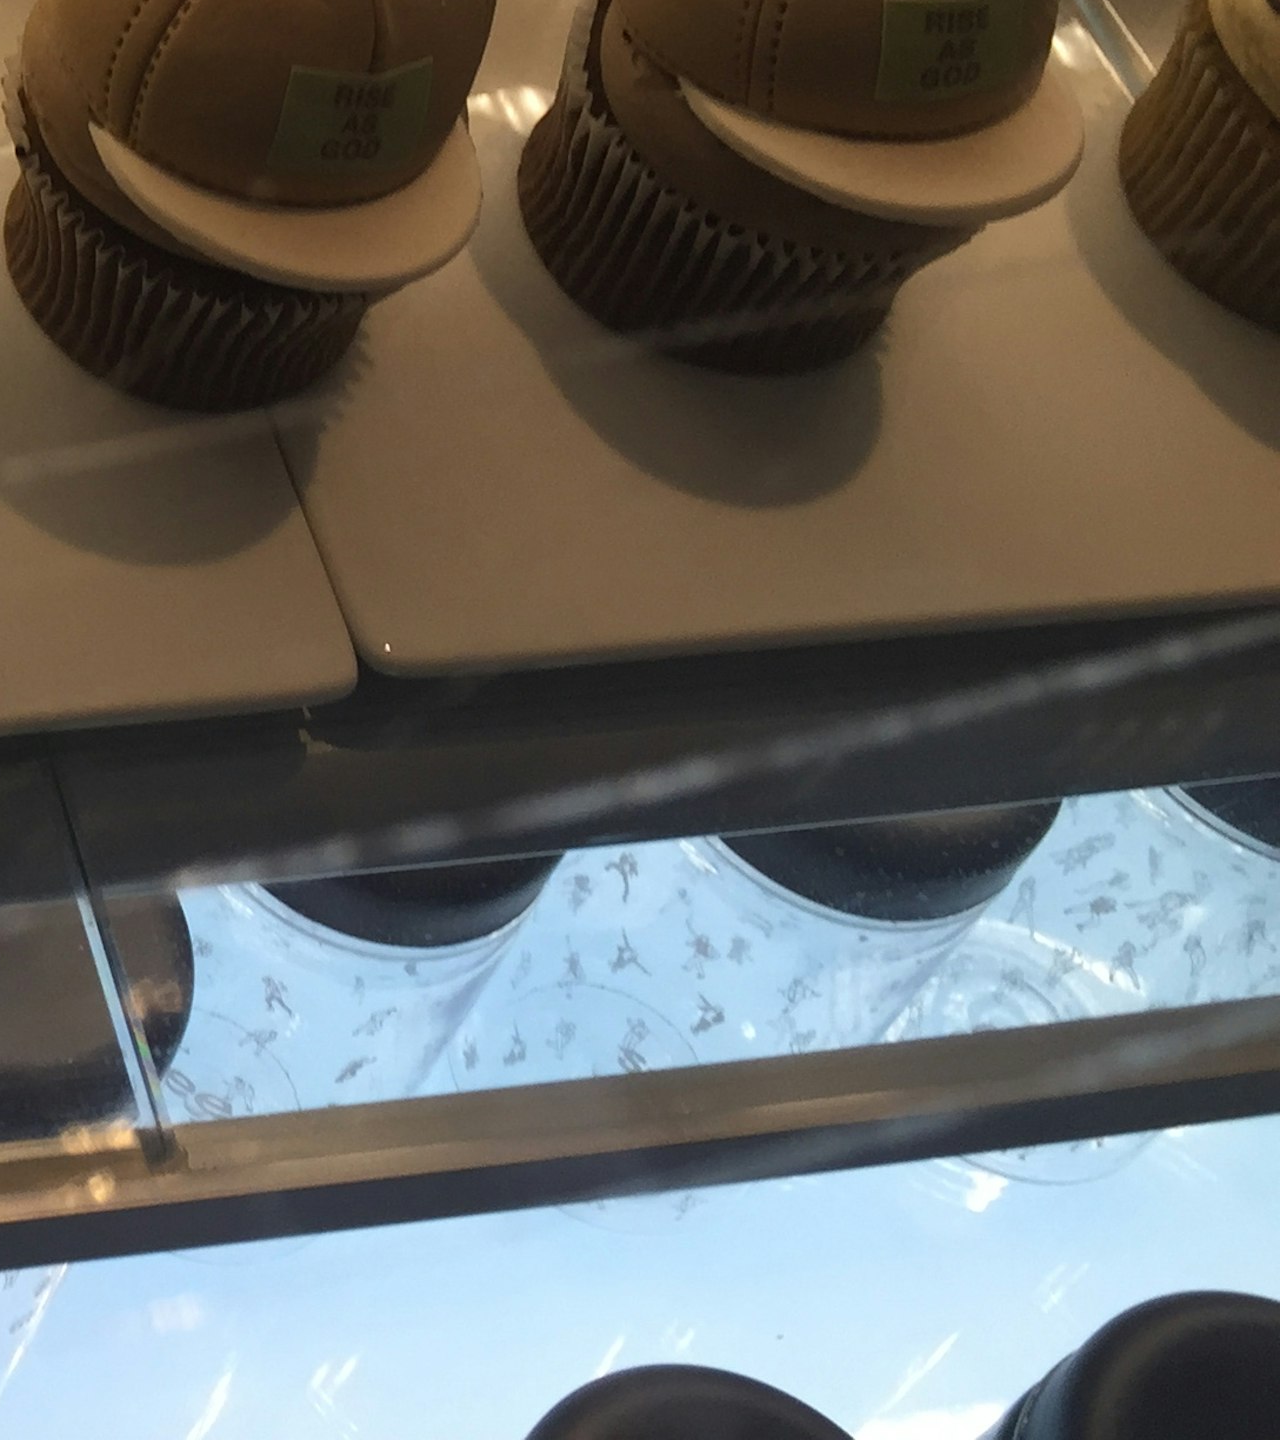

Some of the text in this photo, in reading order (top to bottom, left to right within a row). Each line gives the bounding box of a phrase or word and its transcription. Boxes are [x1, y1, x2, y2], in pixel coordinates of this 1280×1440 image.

[924, 4, 990, 34] RISE
[919, 60, 982, 91] GOD
[334, 80, 398, 111] RISE
[319, 137, 383, 162] GOD
